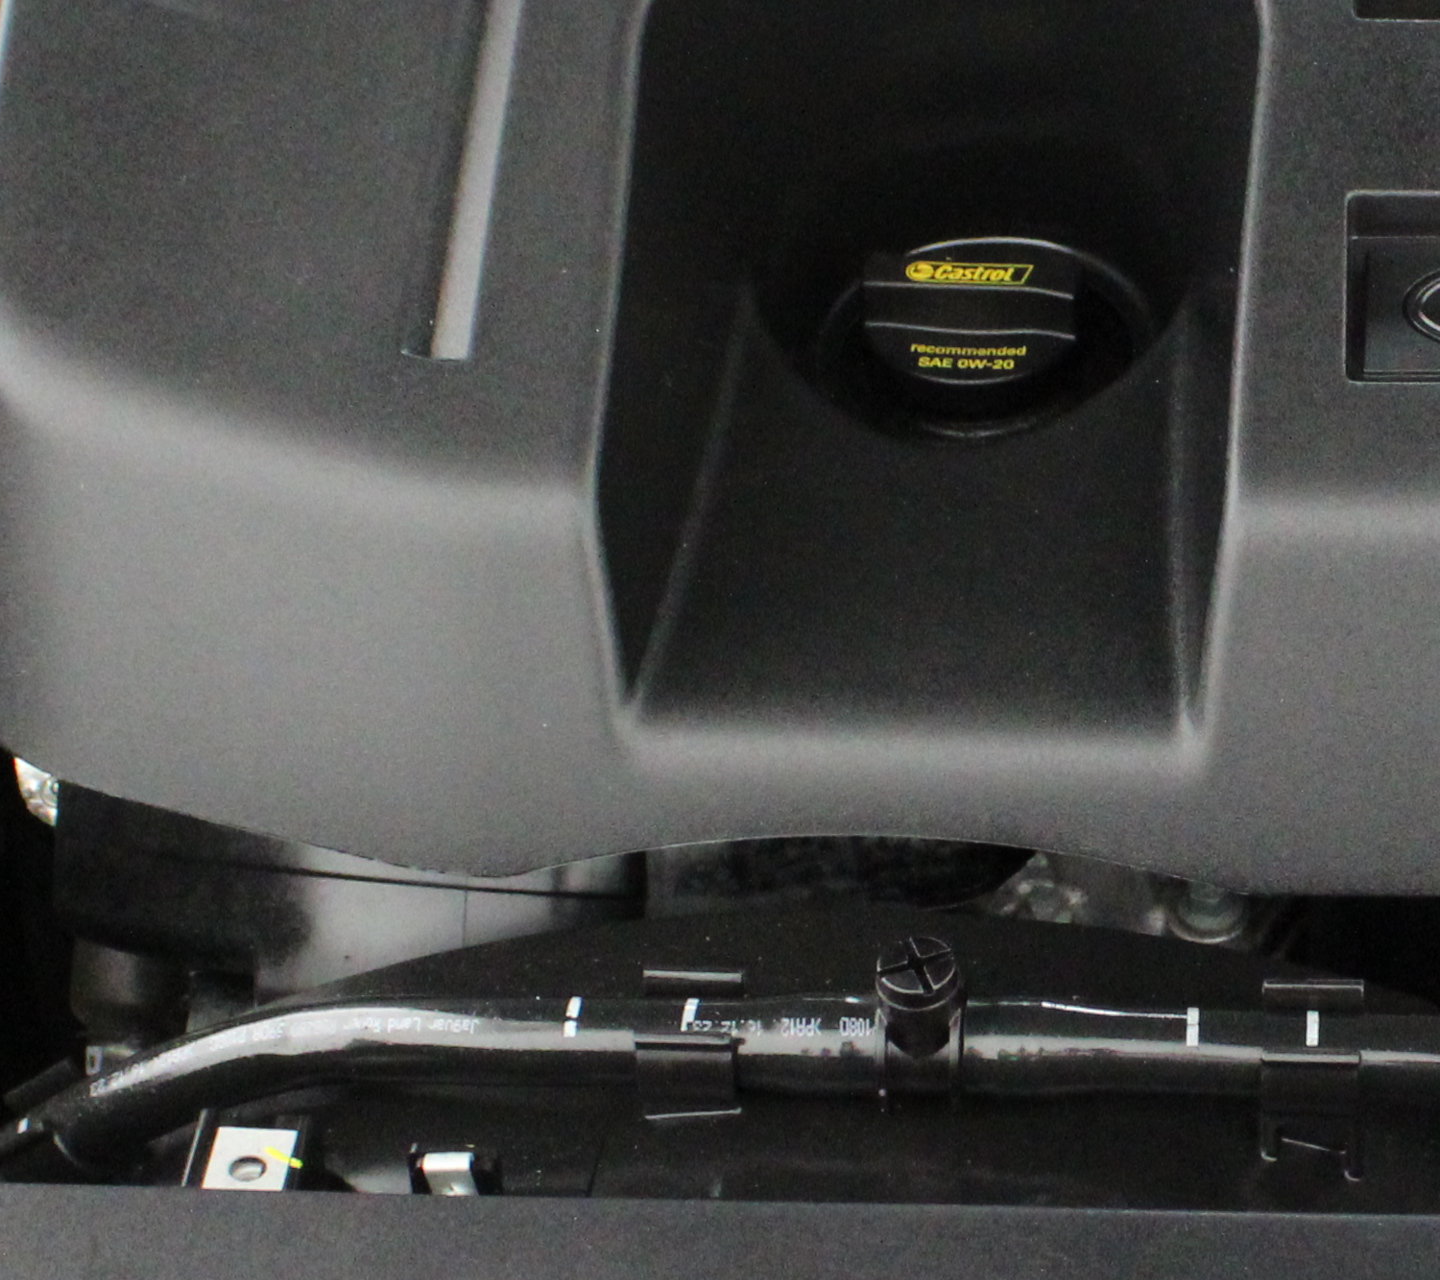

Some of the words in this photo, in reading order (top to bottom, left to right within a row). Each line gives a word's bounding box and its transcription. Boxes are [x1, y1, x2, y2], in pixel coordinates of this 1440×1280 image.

[934, 263, 1015, 281] Castrol
[910, 343, 1027, 357] recommended
[917, 356, 953, 369] SAE
[956, 358, 1015, 371] 0W-20
